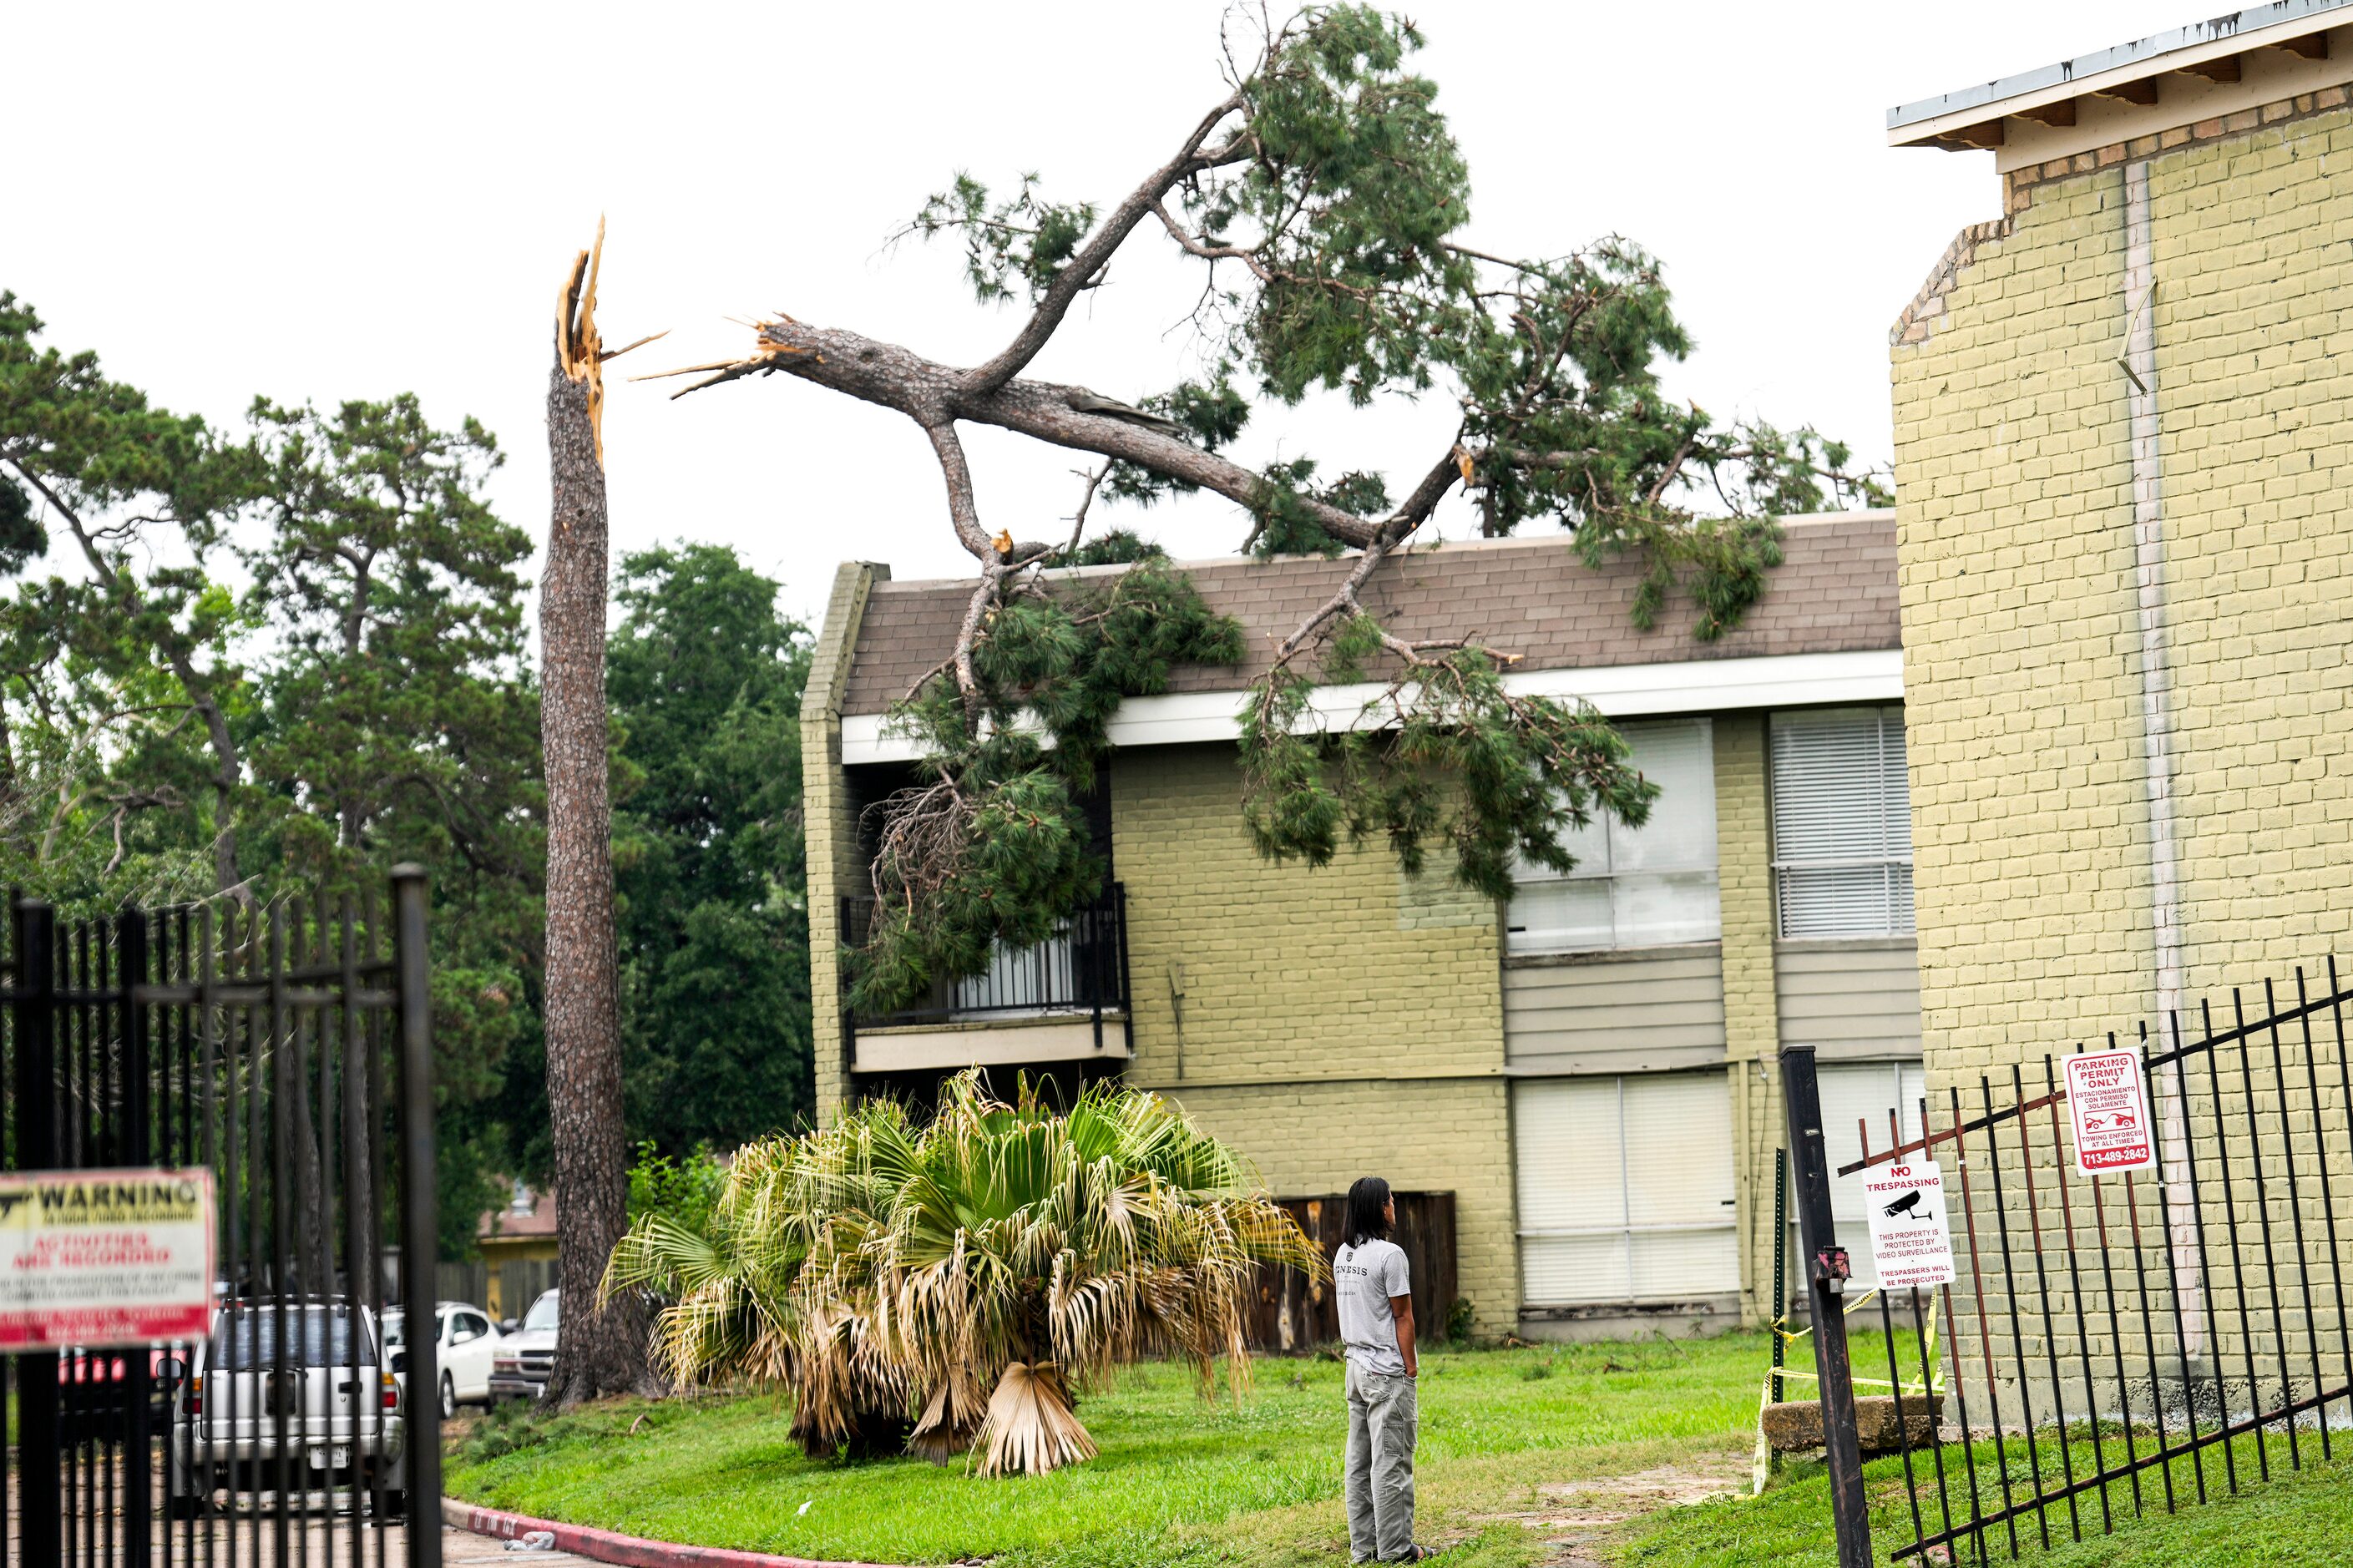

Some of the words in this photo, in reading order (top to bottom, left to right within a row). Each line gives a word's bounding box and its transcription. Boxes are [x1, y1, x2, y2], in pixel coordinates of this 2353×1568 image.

[2074, 1058, 2128, 1071] PARKING
[2080, 1067, 2125, 1080] PERMIT
[2088, 1077, 2120, 1088] ONLY
[2076, 1086, 2136, 1098] ESTACIONAMIENTO
[2100, 1094, 2128, 1102] PERMISO
[2088, 1100, 2127, 1110] SOLAMENTE
[2082, 1134, 2107, 1142] TOWING
[2109, 1130, 2143, 1140] ENFORCED
[2084, 1148, 2148, 1165] 713-489-2842
[1890, 1166, 1910, 1177] NO
[1866, 1178, 1939, 1191] TRESPASSING
[40, 1181, 195, 1211] WARNING
[1895, 1230, 1930, 1239] PROPERTY
[1885, 1239, 1925, 1249] PROTECTED
[1897, 1246, 1948, 1257] SURVEILLANCE
[1880, 1267, 1930, 1277] TRESPASSERS
[1897, 1275, 1945, 1284] PROSECUTED
